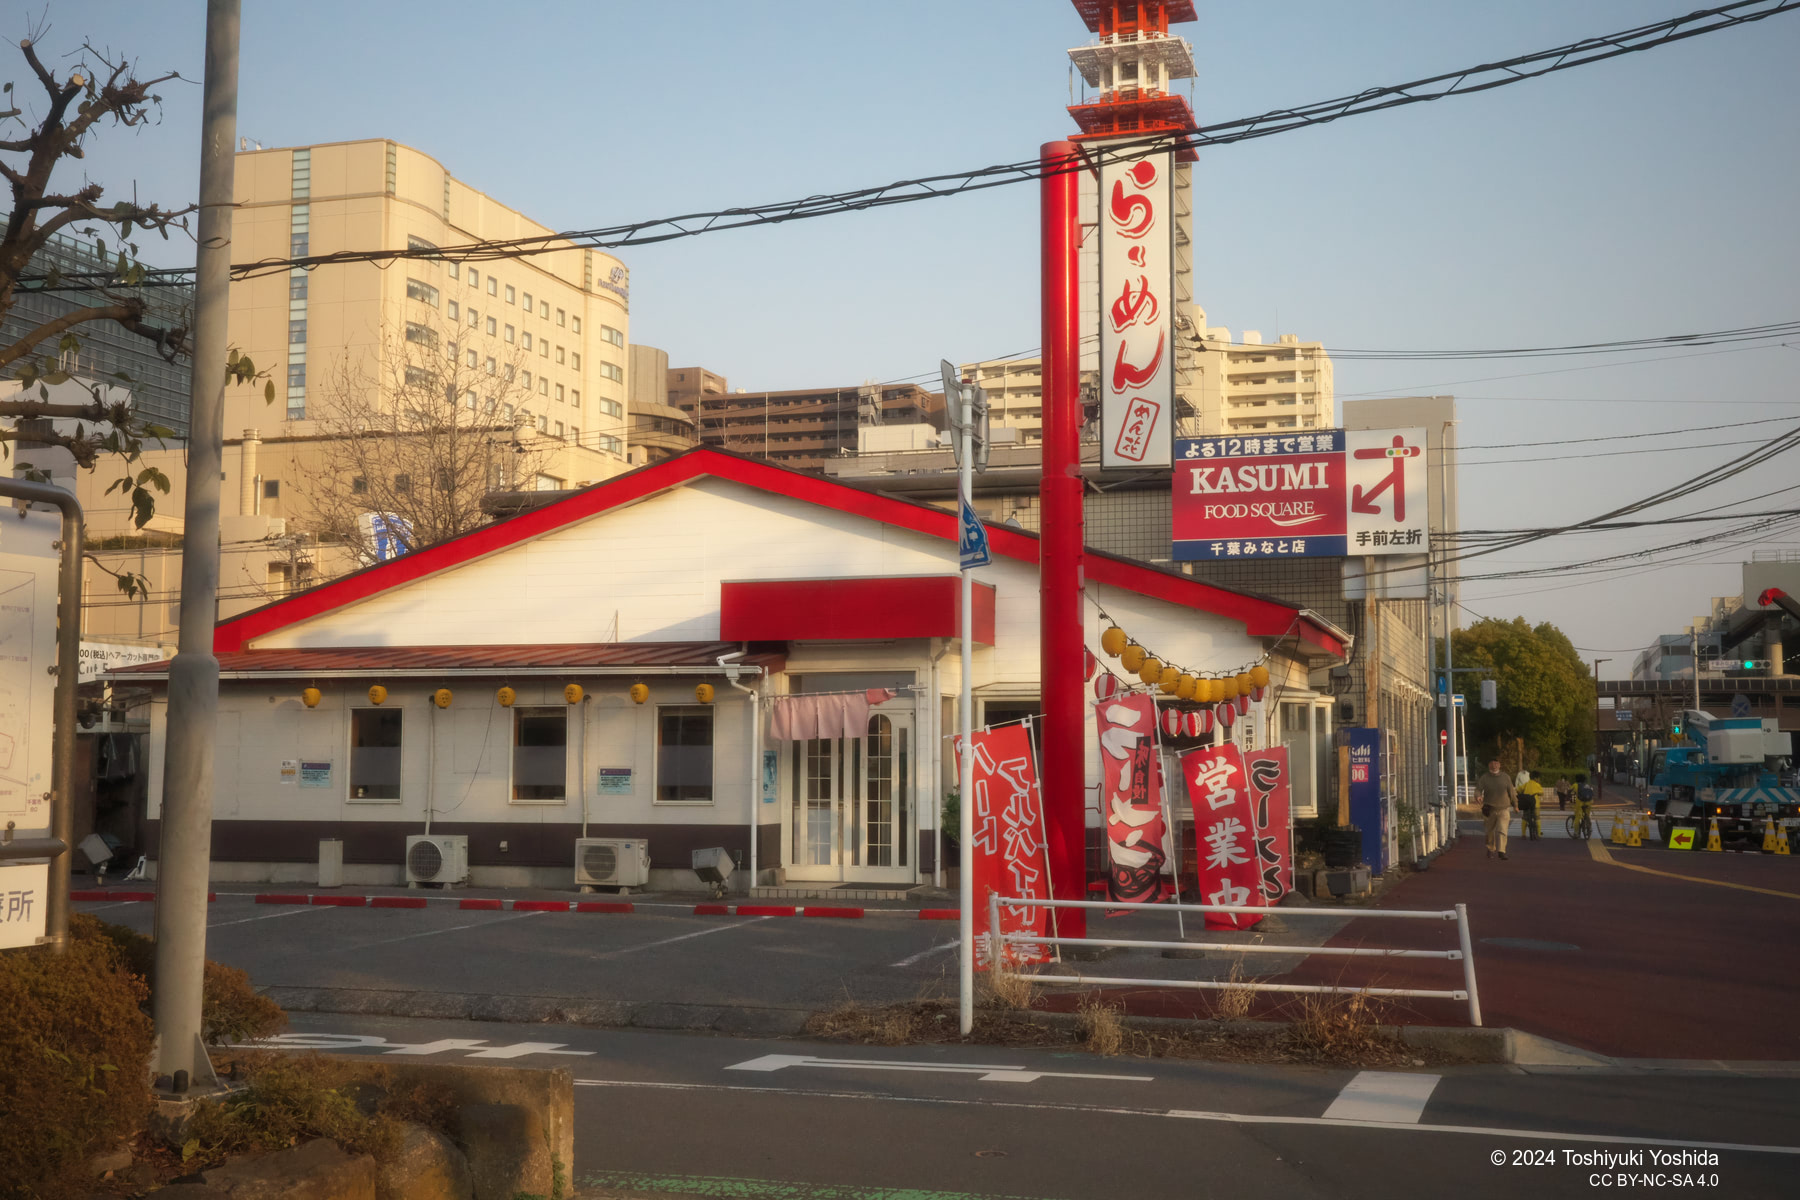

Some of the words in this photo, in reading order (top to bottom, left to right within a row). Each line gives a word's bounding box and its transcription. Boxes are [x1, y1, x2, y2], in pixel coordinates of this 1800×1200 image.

[1108, 160, 1165, 395] らーめん
[1184, 434, 1334, 459] よる12時まで営業
[1189, 462, 1329, 494] KASUMI
[1204, 503, 1248, 519] FOOD
[1250, 501, 1316, 521] SQUARE
[1210, 539, 1306, 556] 千葉みなと店
[1355, 529, 1422, 547] 手前左折
[1195, 756, 1251, 925] 営業中
[0, 890, 34, 923] 所
